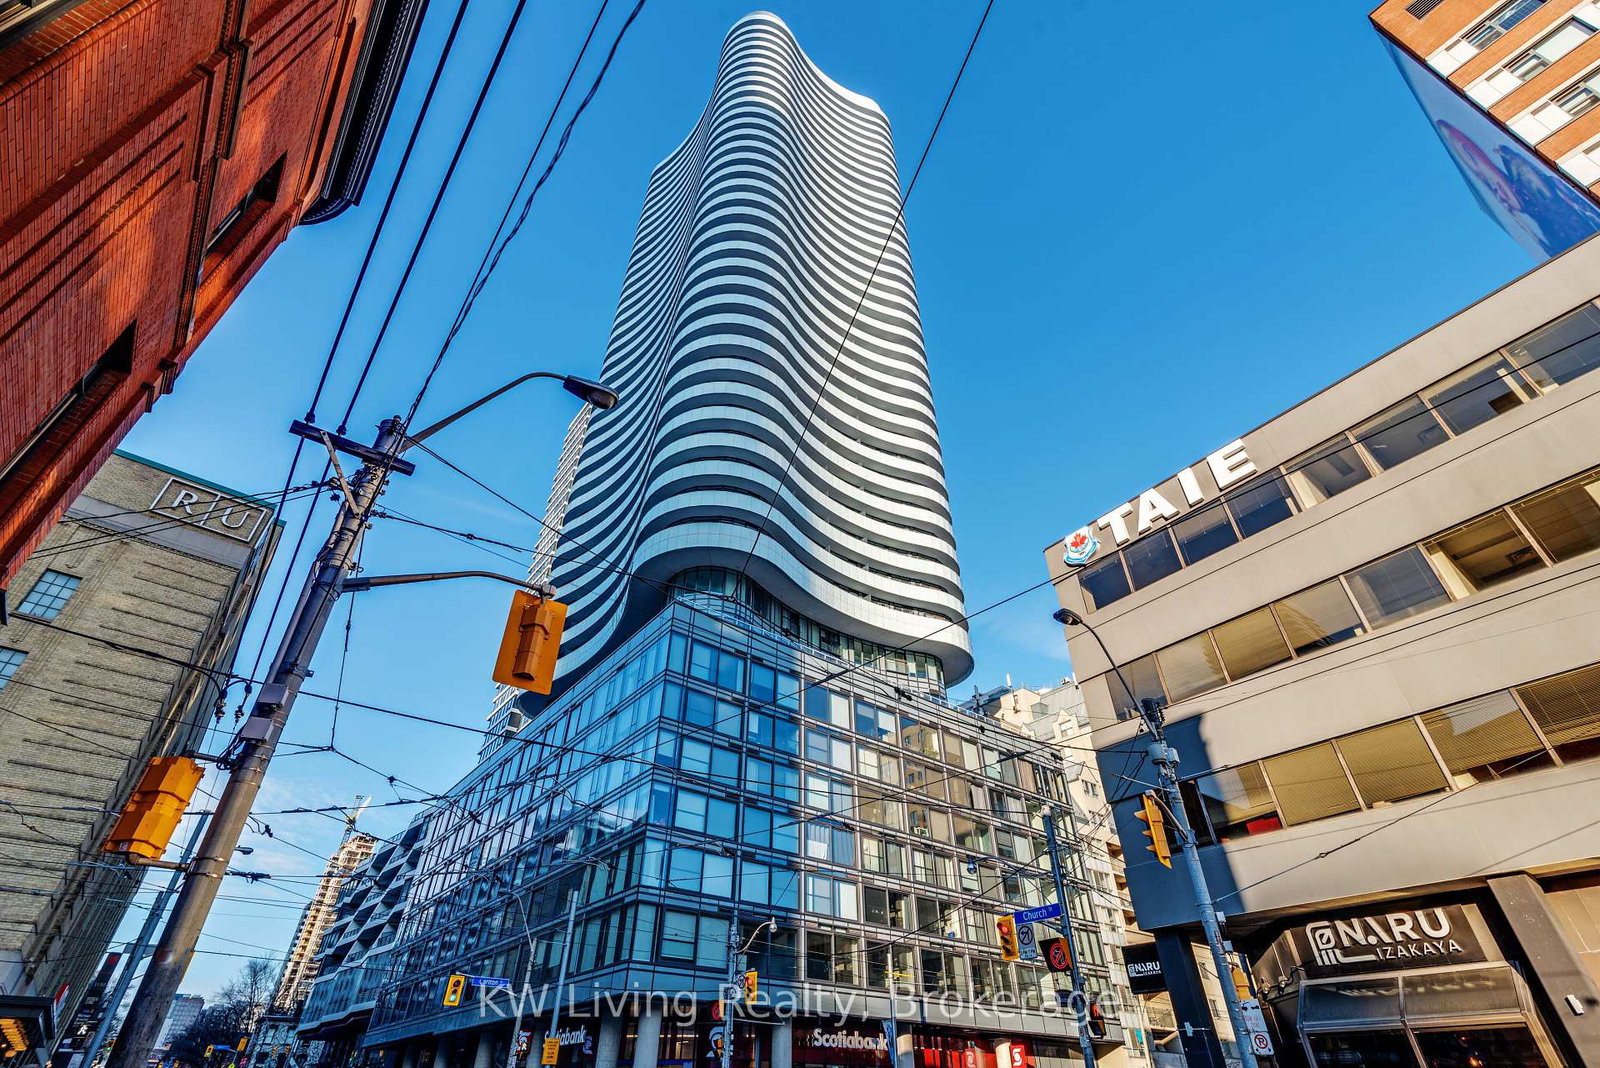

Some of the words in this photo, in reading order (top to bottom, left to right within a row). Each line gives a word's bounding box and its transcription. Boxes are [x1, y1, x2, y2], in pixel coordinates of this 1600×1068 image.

[1097, 437, 1258, 547] TAIE
[1022, 908, 1048, 921] Church
[1376, 939, 1463, 961] IZAKAYA
